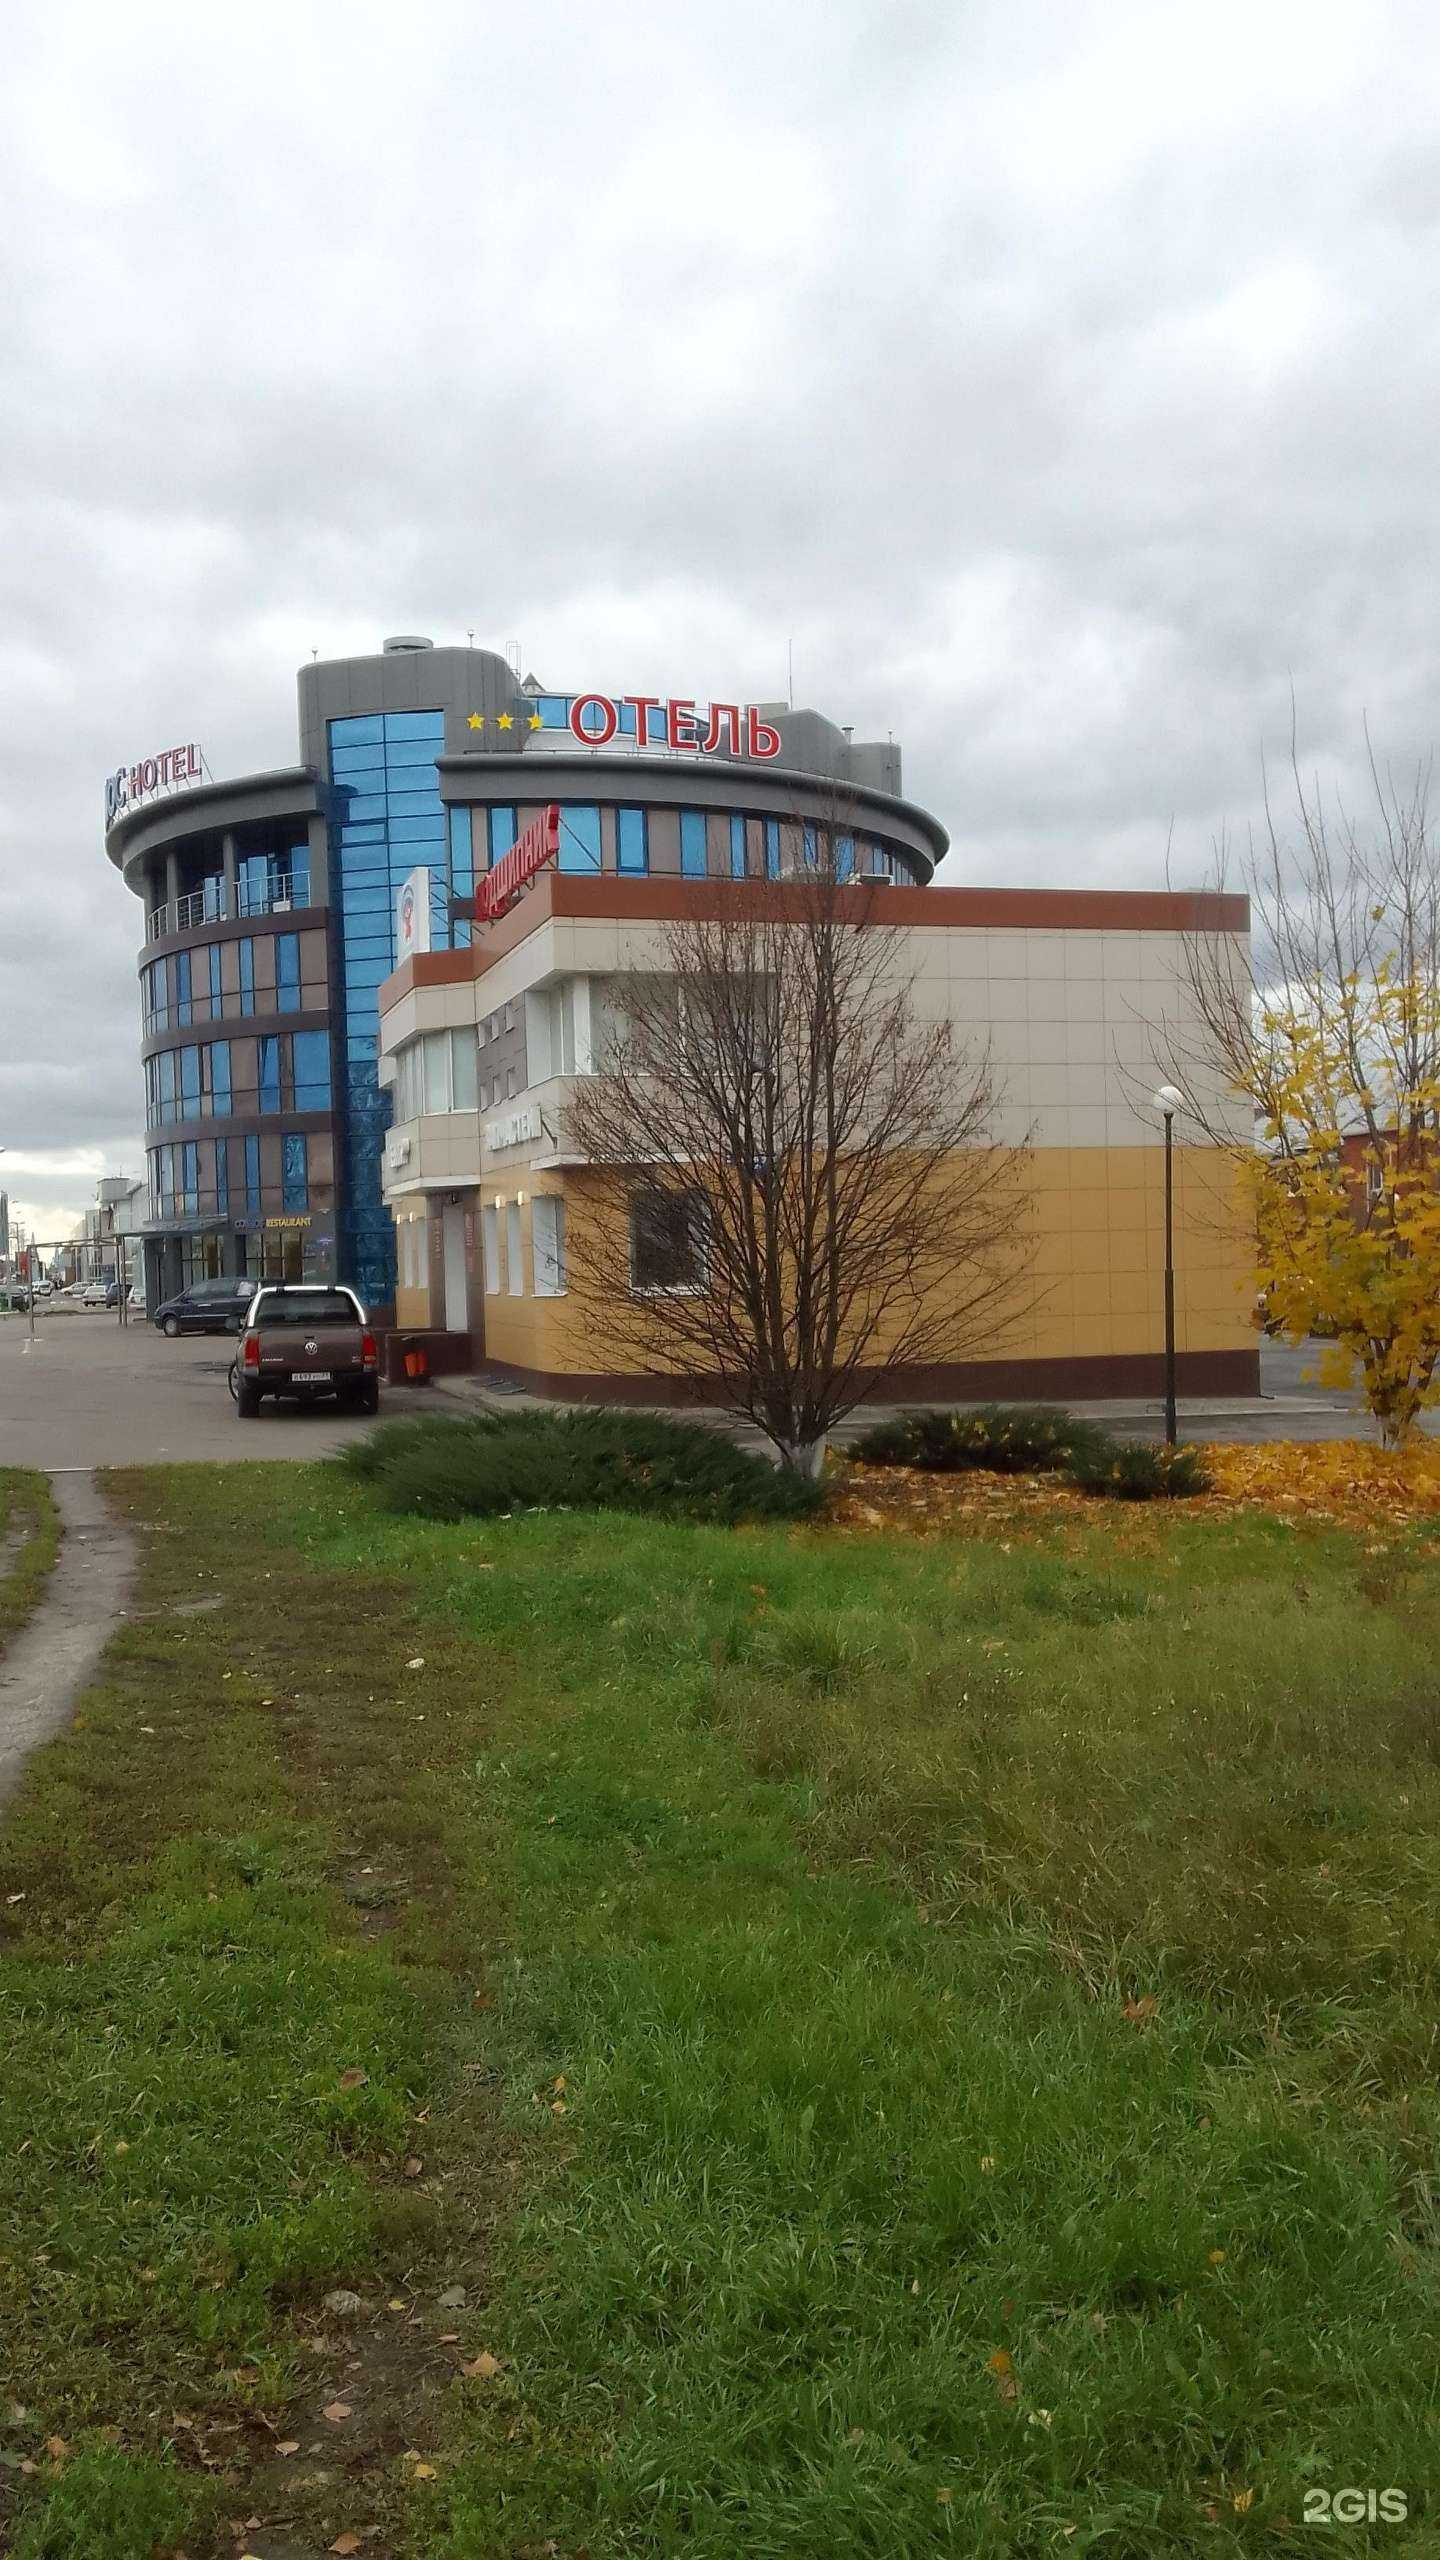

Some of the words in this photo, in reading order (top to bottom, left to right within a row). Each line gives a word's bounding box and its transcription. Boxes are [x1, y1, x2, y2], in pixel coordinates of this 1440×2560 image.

[569, 693, 782, 759] ОТЕЛЬ
[128, 743, 202, 799] HOTEL
[475, 804, 560, 922] ДШИПНИК
